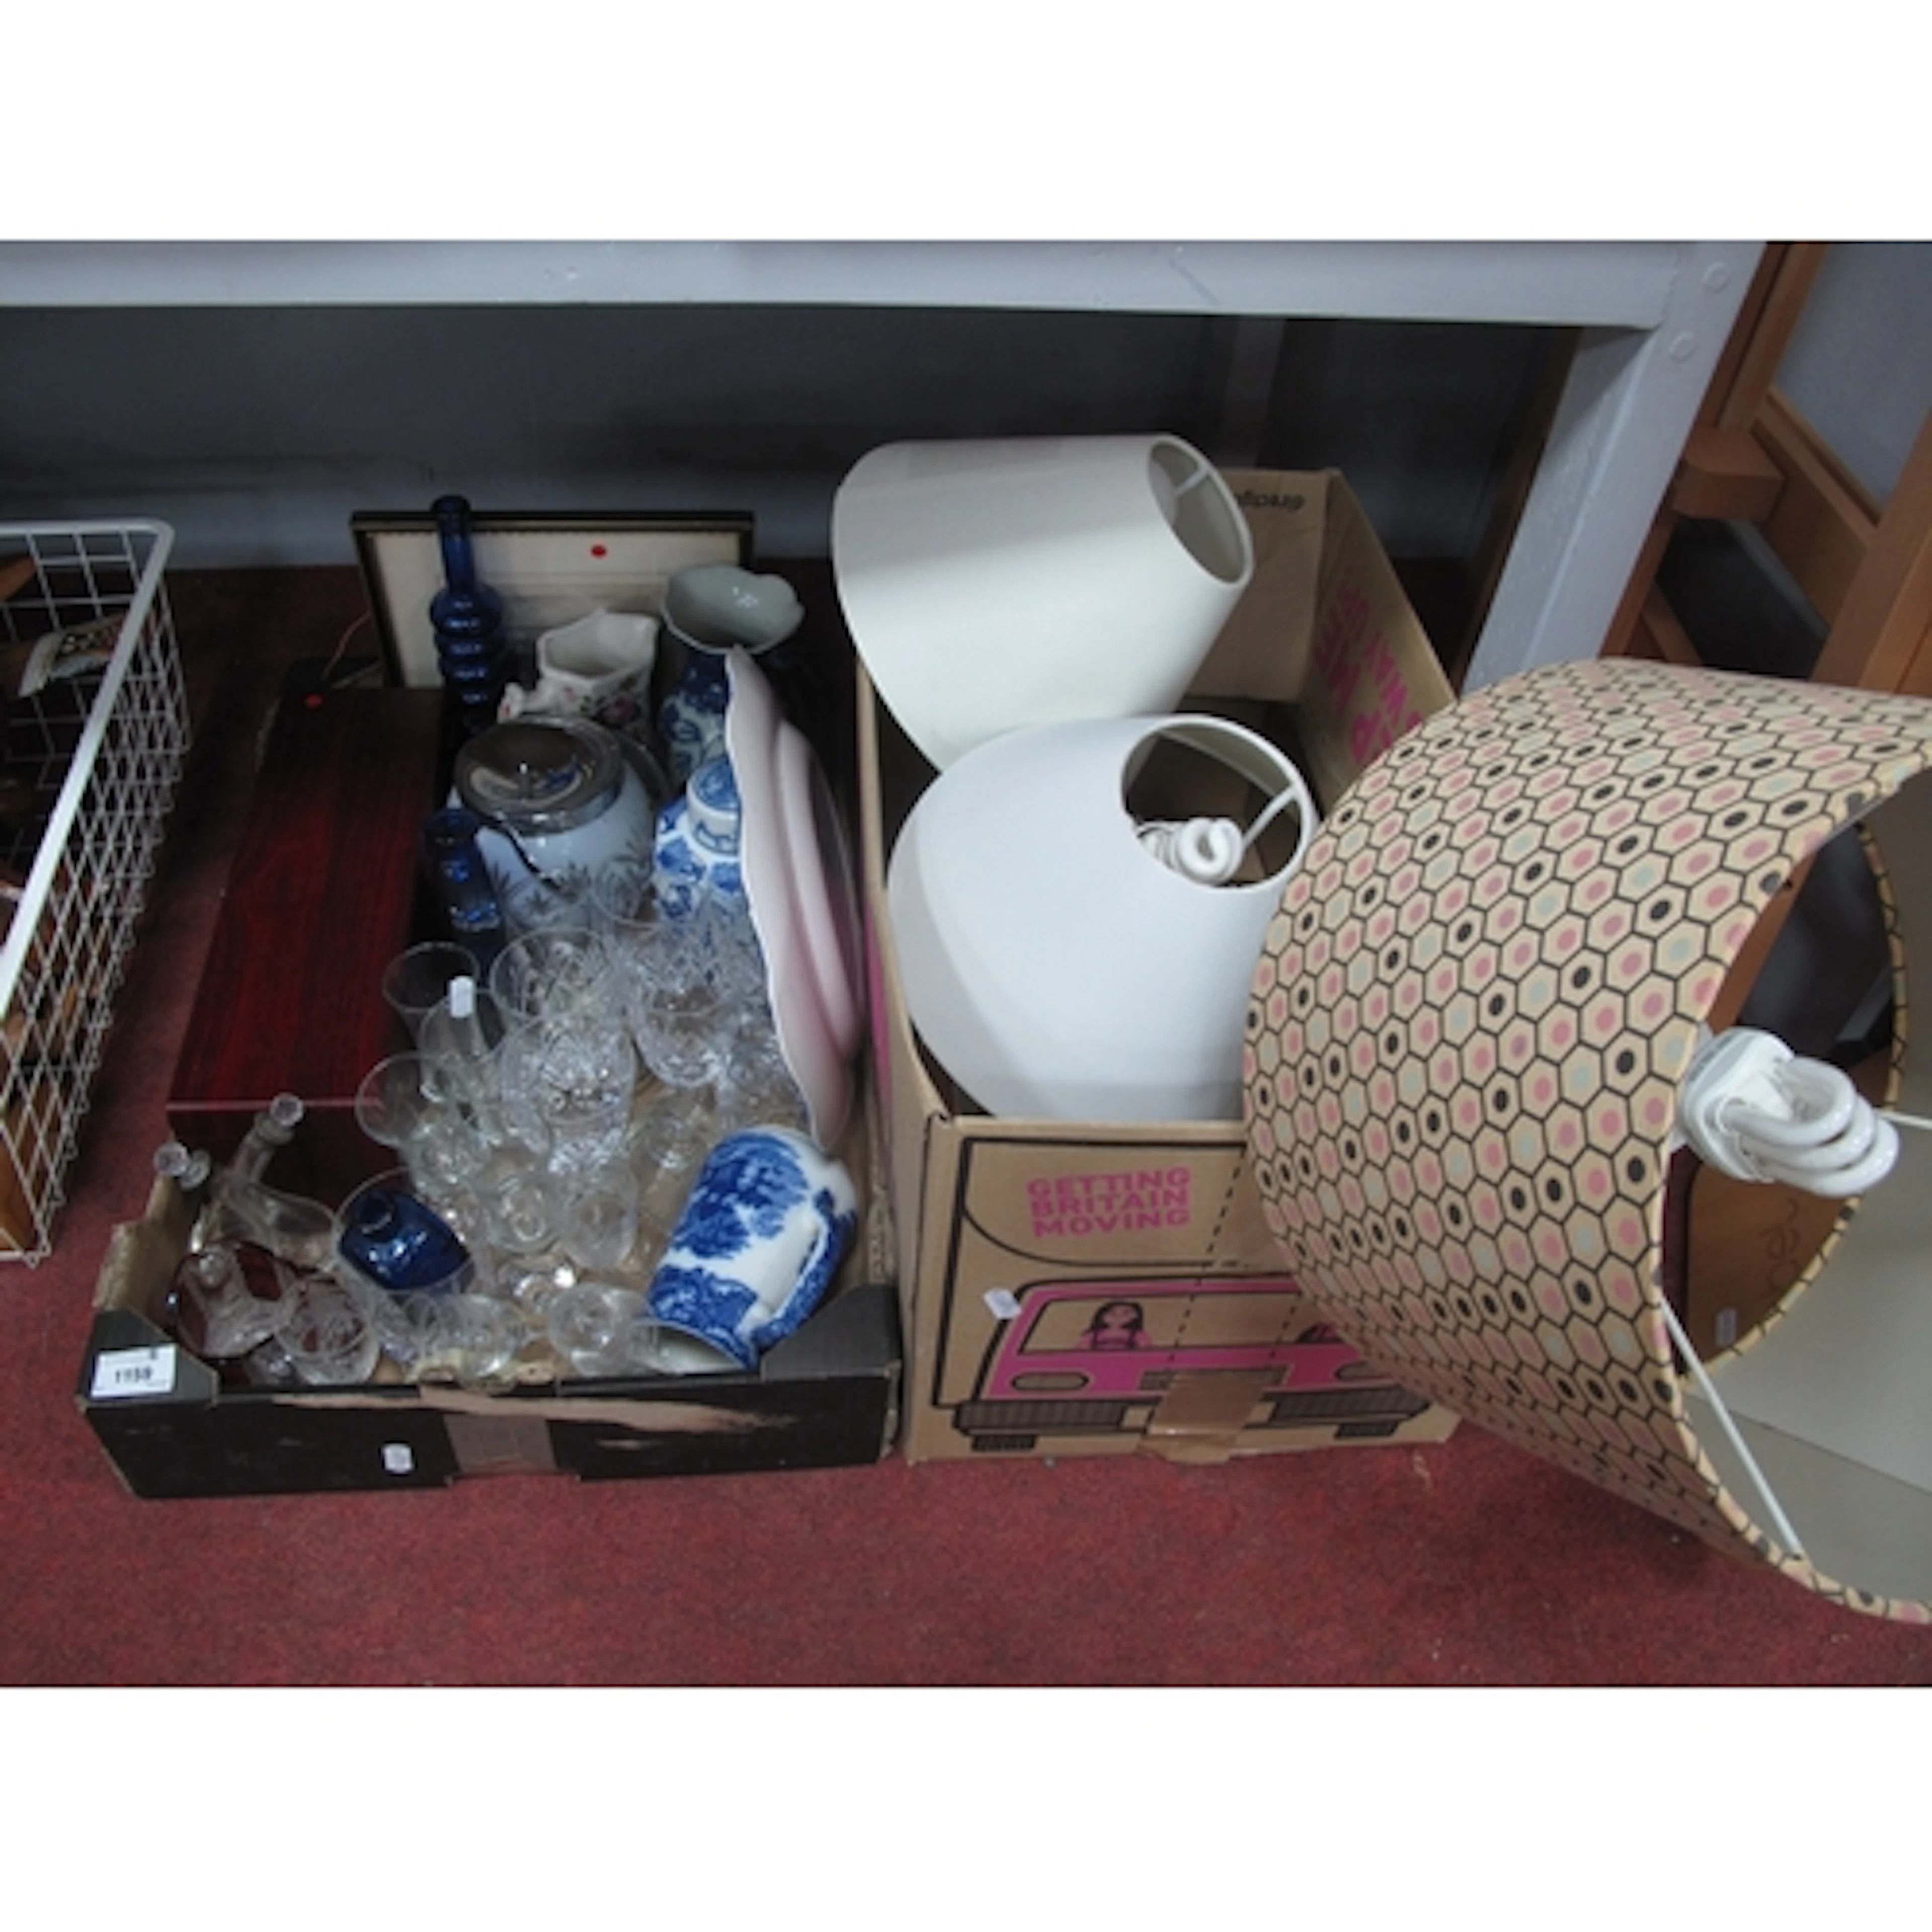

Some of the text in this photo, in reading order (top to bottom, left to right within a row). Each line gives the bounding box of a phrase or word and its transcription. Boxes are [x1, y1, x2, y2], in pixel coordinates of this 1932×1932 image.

[1028, 1167, 1190, 1195] GETTING
[1031, 1189, 1188, 1217] BRITAIN
[1035, 1209, 1190, 1237] MOVING
